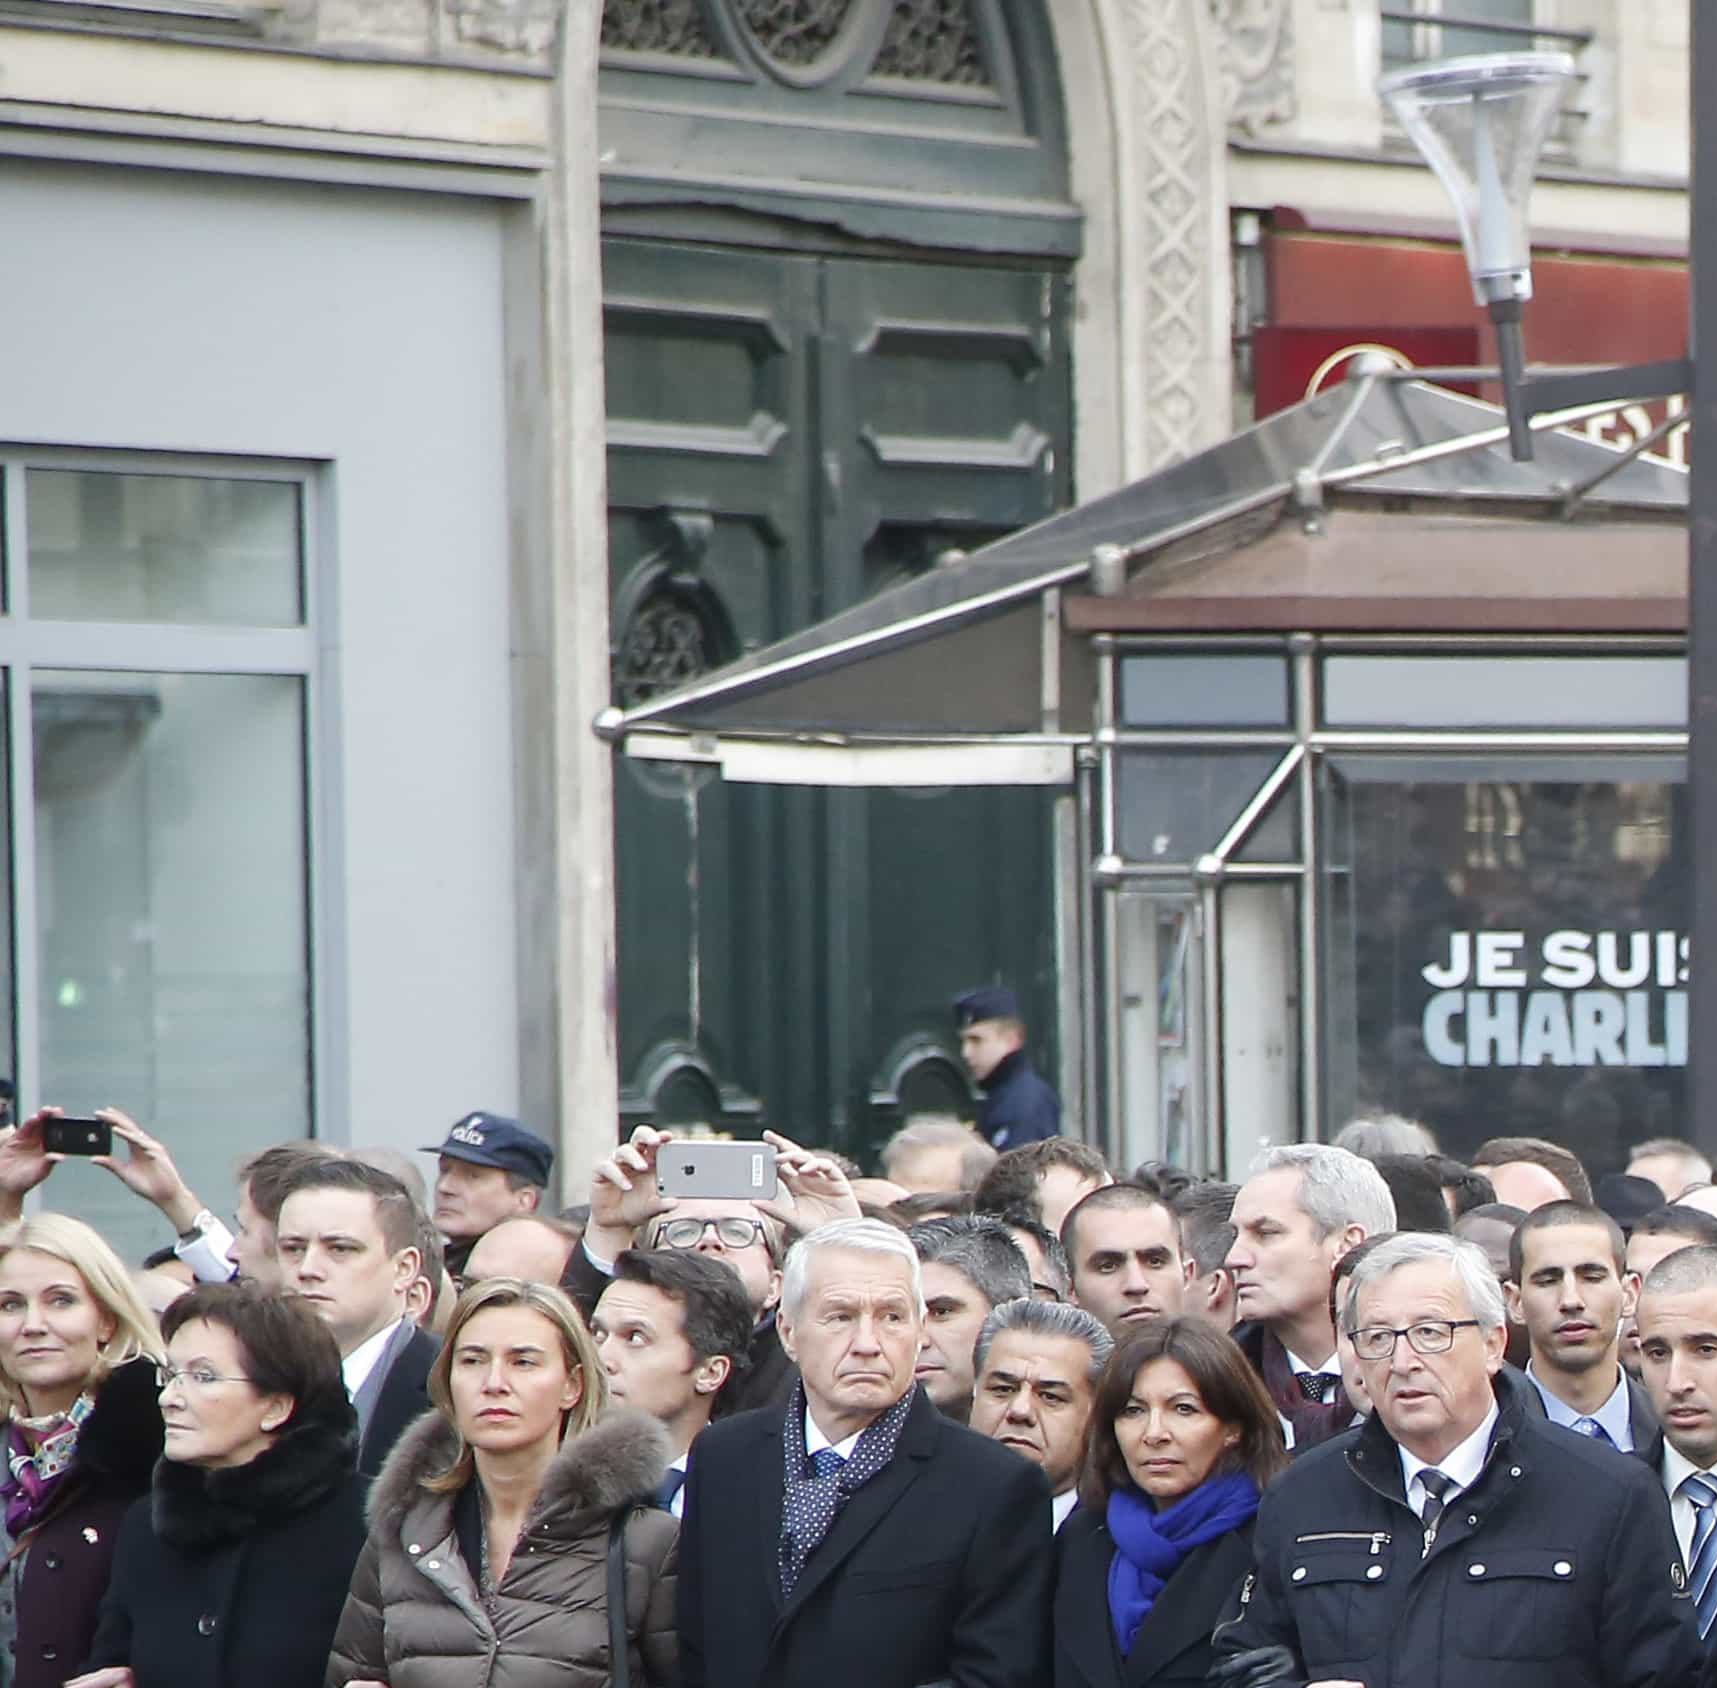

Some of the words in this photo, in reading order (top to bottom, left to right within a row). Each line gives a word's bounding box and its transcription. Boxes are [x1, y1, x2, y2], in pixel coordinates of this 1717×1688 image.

[1421, 931, 1527, 988] JE
[1541, 930, 1690, 988] SUI
[1423, 989, 1689, 1066] CHARLI
